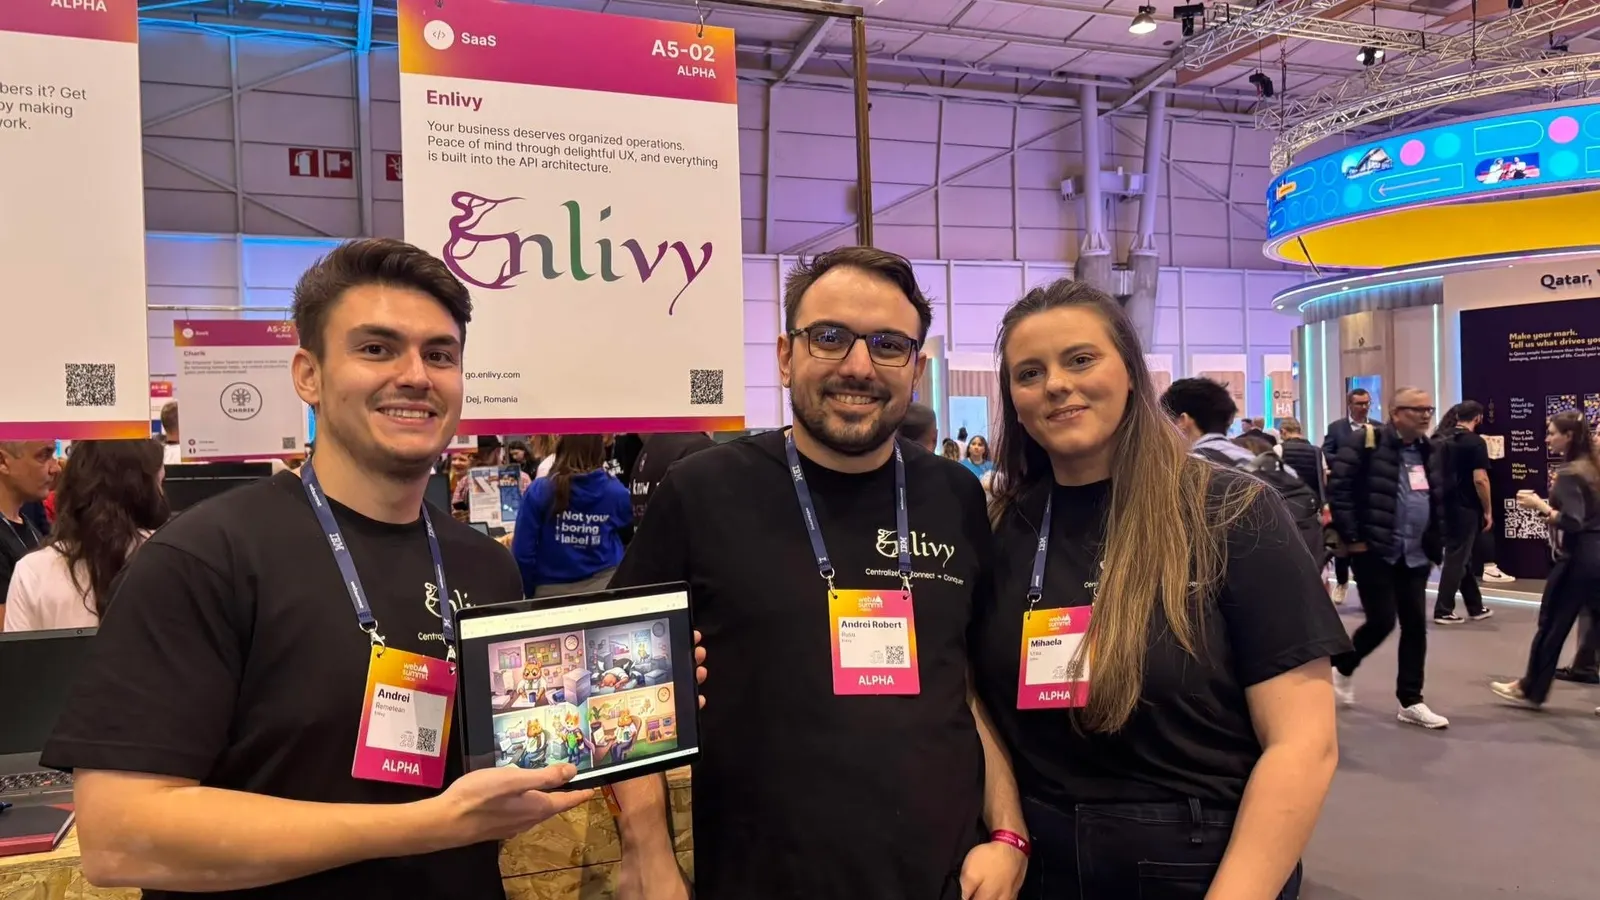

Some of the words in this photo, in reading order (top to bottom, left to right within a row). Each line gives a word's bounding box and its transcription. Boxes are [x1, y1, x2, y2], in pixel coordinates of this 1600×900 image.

[461, 32, 497, 47] SaaS
[651, 39, 716, 63] A5-02
[677, 64, 716, 79] ALPHA
[37, 84, 56, 98] it?
[60, 87, 88, 101] Get
[426, 89, 483, 112] Enlivy
[19, 102, 73, 119] making
[427, 120, 454, 132] Your
[458, 123, 510, 137] business
[513, 127, 566, 141] deserves
[568, 133, 623, 145] organized
[626, 138, 685, 151] operations.
[427, 135, 465, 148] Peace
[468, 138, 481, 149] of
[484, 141, 513, 152] mind
[516, 142, 560, 157] through
[564, 145, 616, 159] delightful
[618, 150, 638, 163] UX,
[640, 153, 660, 163] and
[663, 155, 718, 169] everything
[427, 150, 438, 161] is
[441, 152, 467, 163] built
[470, 153, 493, 165] into
[496, 155, 516, 166] the
[519, 157, 538, 168] API
[541, 160, 612, 174] architecture.
[443, 190, 713, 316] Enlivy
[1540, 274, 1592, 290] Qatar,
[1509, 333, 1532, 341] Make
[1533, 332, 1552, 341] your
[1509, 341, 1524, 349] Tell
[1536, 339, 1558, 347] what
[1559, 337, 1586, 346] drives
[465, 371, 521, 380] go.enlivy.com
[465, 395, 482, 405] Dej,
[483, 395, 518, 404] Romania
[792, 465, 803, 482] IBM
[562, 510, 584, 522] Not
[585, 514, 610, 525] your
[561, 522, 600, 535] boring
[329, 532, 345, 552] IBM
[561, 534, 589, 546] label
[900, 536, 908, 553] IBM
[841, 620, 871, 628] Andrei
[872, 621, 902, 629] Robert
[1030, 638, 1062, 647] Mihaela
[403, 662, 419, 670] web
[402, 669, 429, 681] summit
[858, 675, 894, 685] ALPHA
[377, 688, 411, 703] Andrei
[1038, 689, 1071, 701] ALPHA
[381, 758, 420, 775] ALPHA
